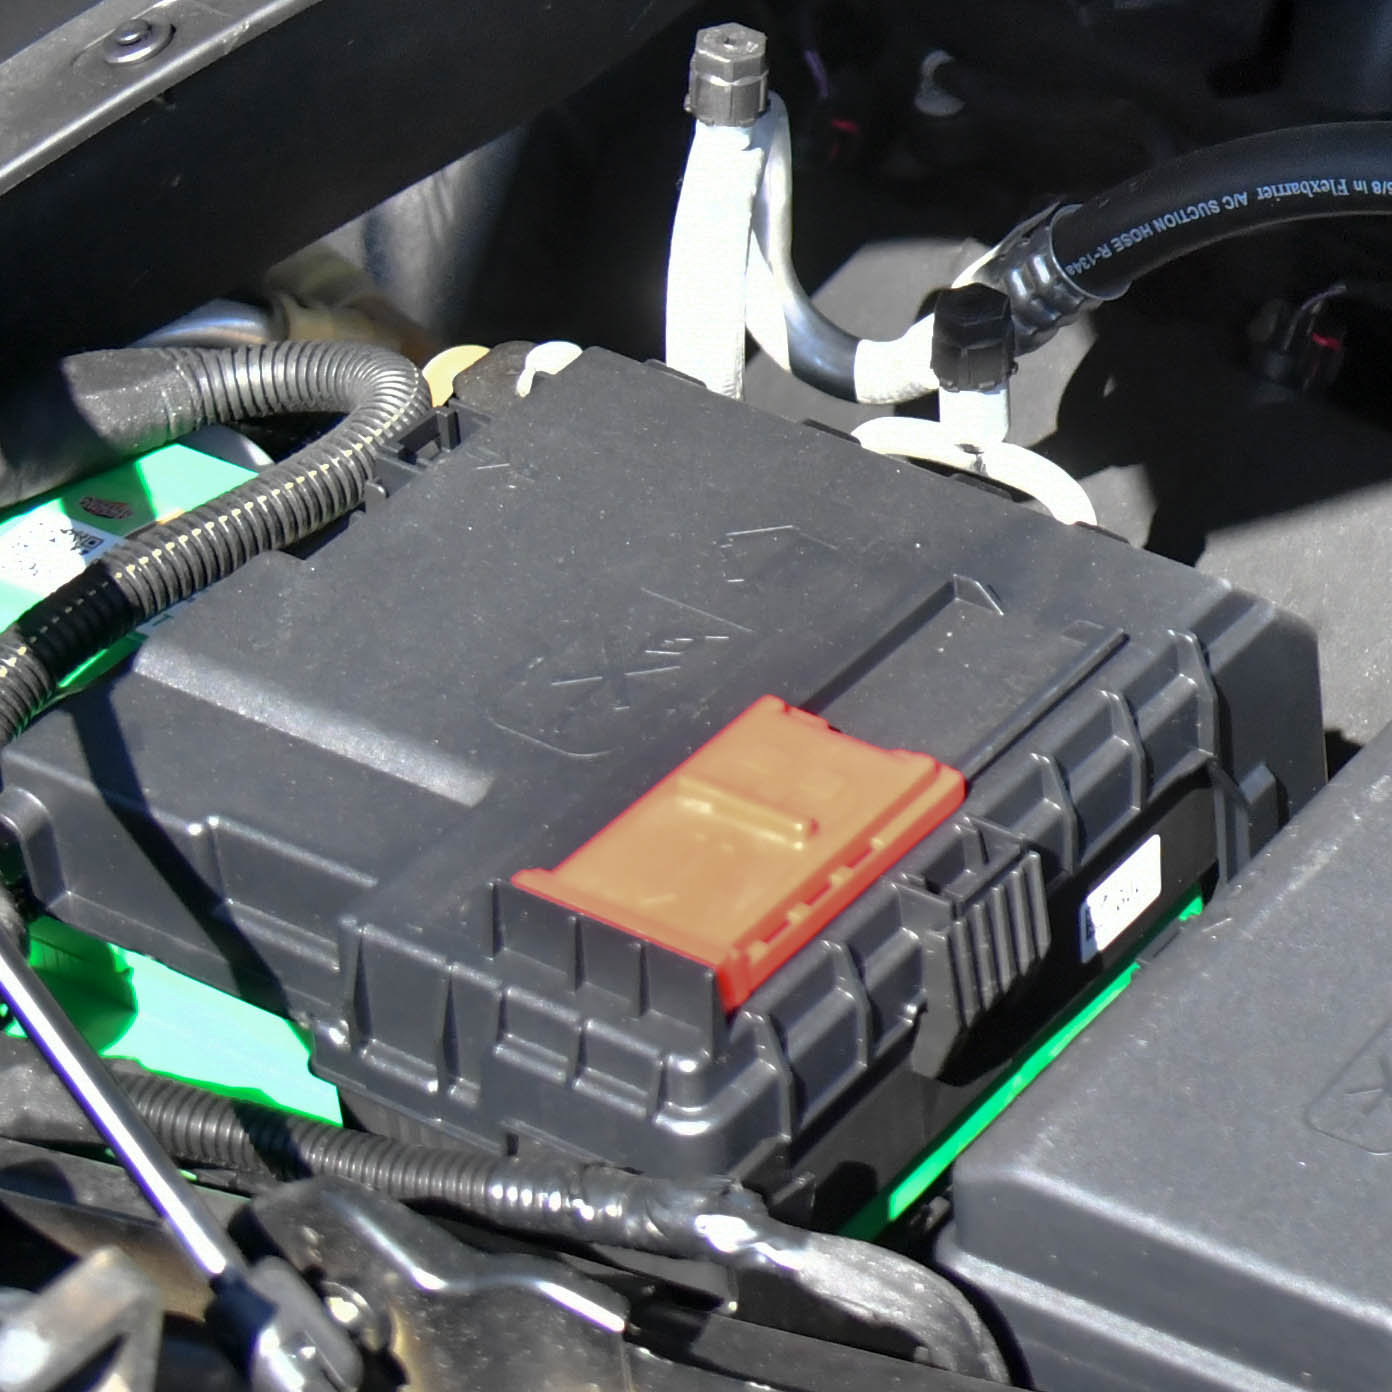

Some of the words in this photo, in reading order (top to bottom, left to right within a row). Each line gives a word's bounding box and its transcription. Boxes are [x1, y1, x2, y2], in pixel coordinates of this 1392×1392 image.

[1221, 191, 1249, 210] A/C
[1255, 178, 1349, 200] Flexbarrier
[1154, 199, 1221, 233] SUCTION
[1110, 224, 1154, 253] HOSE
[1064, 244, 1113, 277] R-134a
